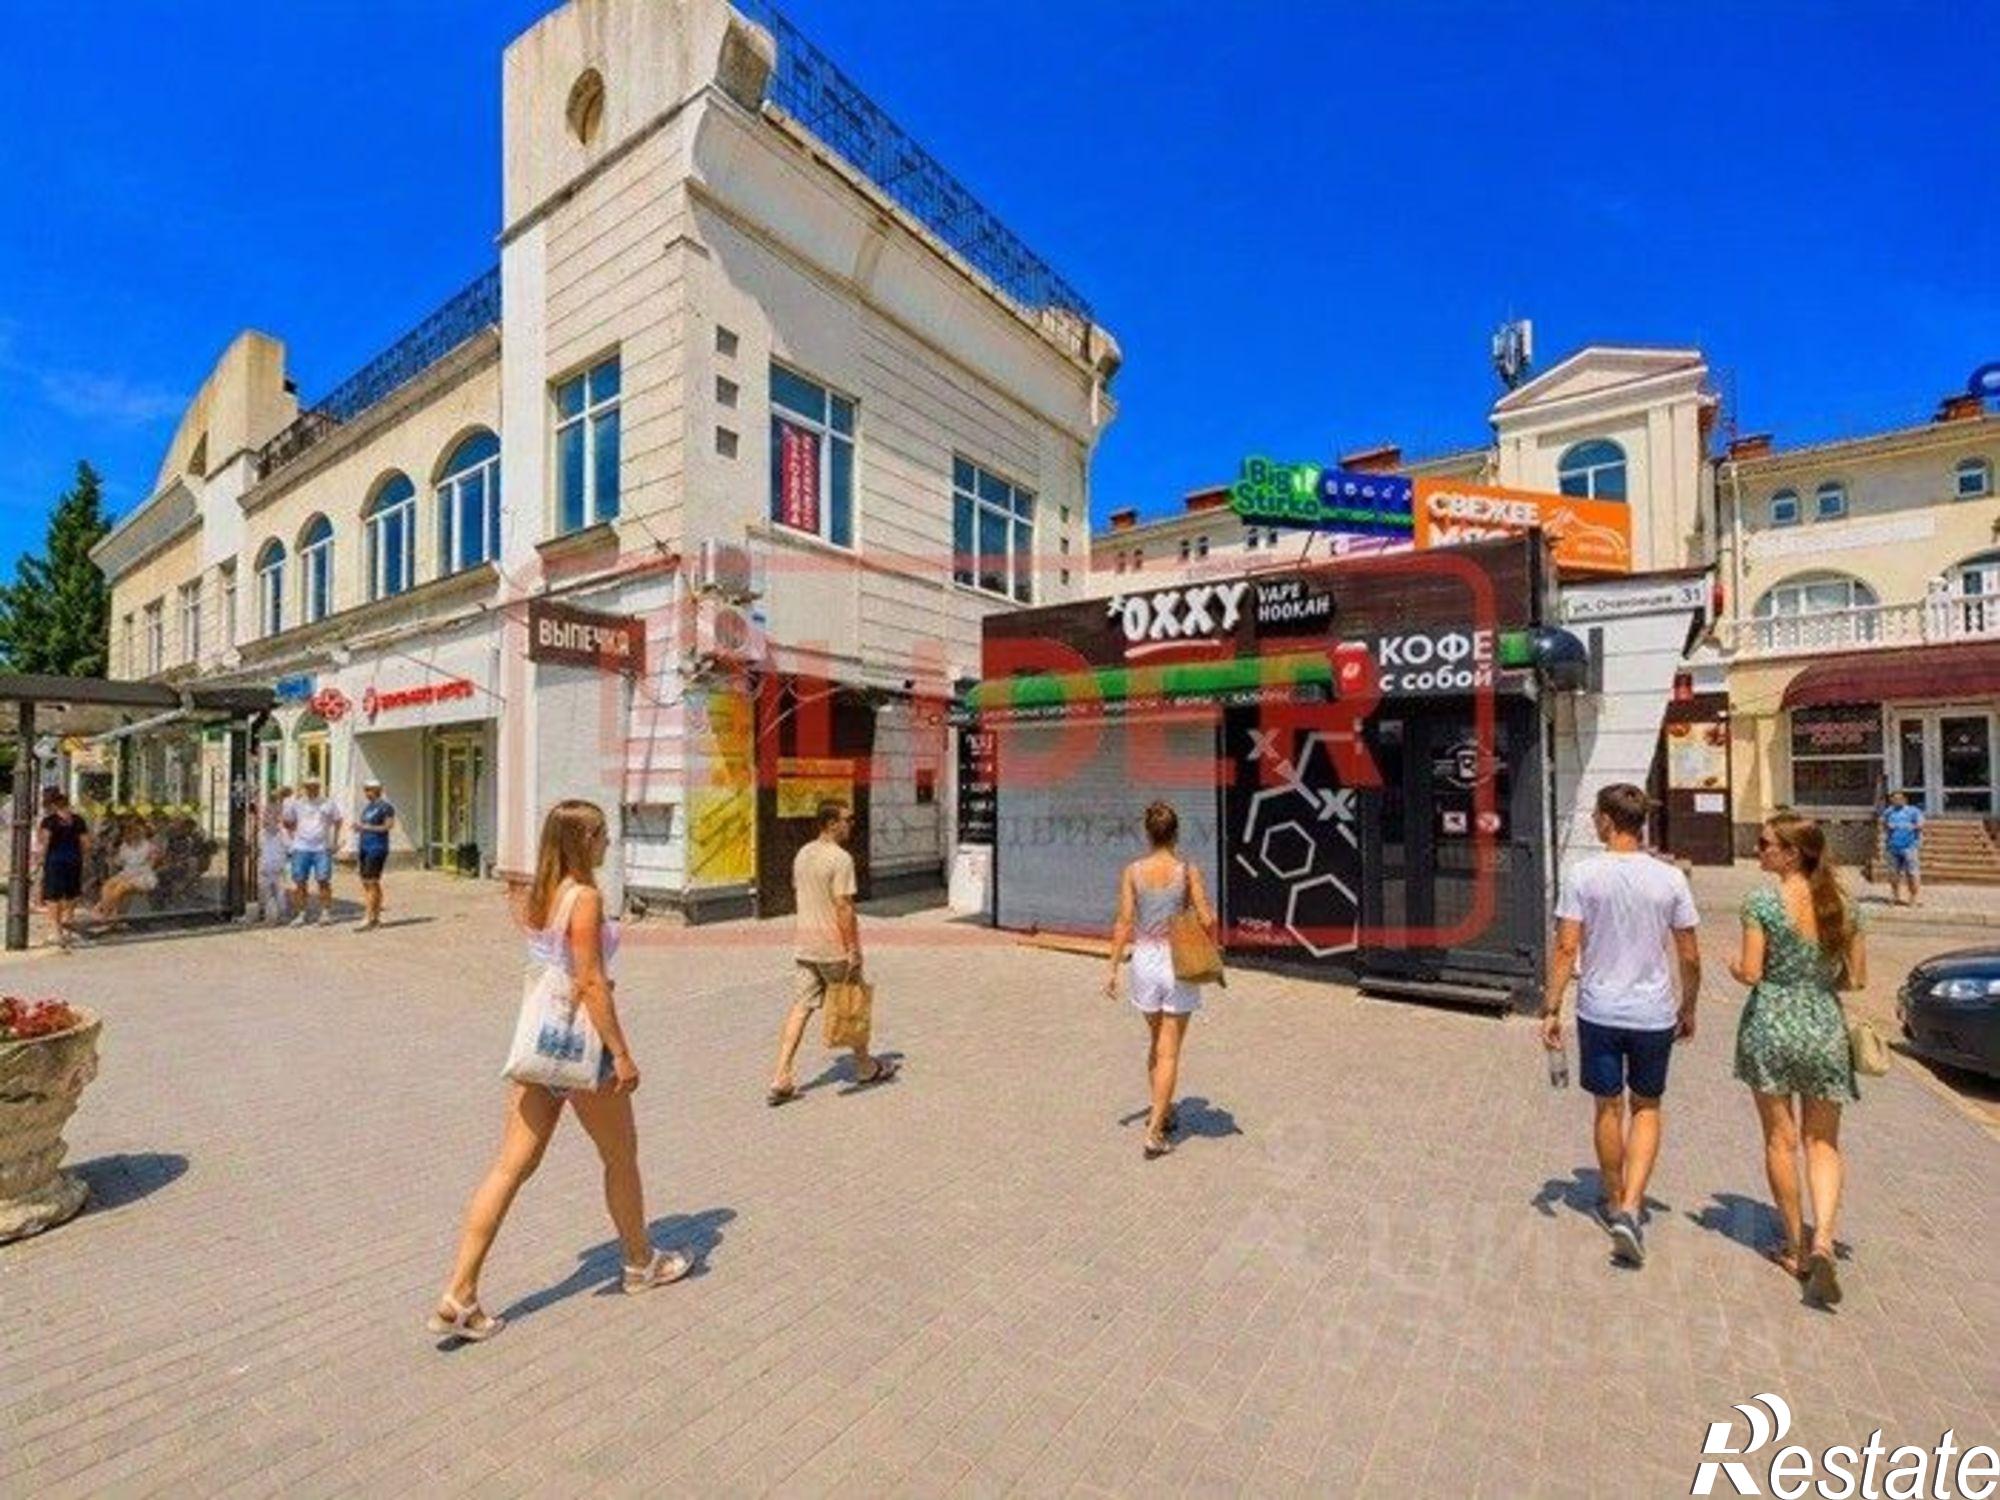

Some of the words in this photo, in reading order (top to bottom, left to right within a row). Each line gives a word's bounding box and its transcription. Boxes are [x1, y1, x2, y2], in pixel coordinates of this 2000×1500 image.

[1257, 583, 1301, 604] VAPE
[1257, 595, 1331, 622] HOOKAH
[1121, 581, 1250, 641] OXXY
[538, 617, 630, 656] ВЫПЕЧКА
[1378, 630, 1493, 666] КОФЕ
[1378, 672, 1395, 691] с
[1401, 662, 1493, 690] собой
